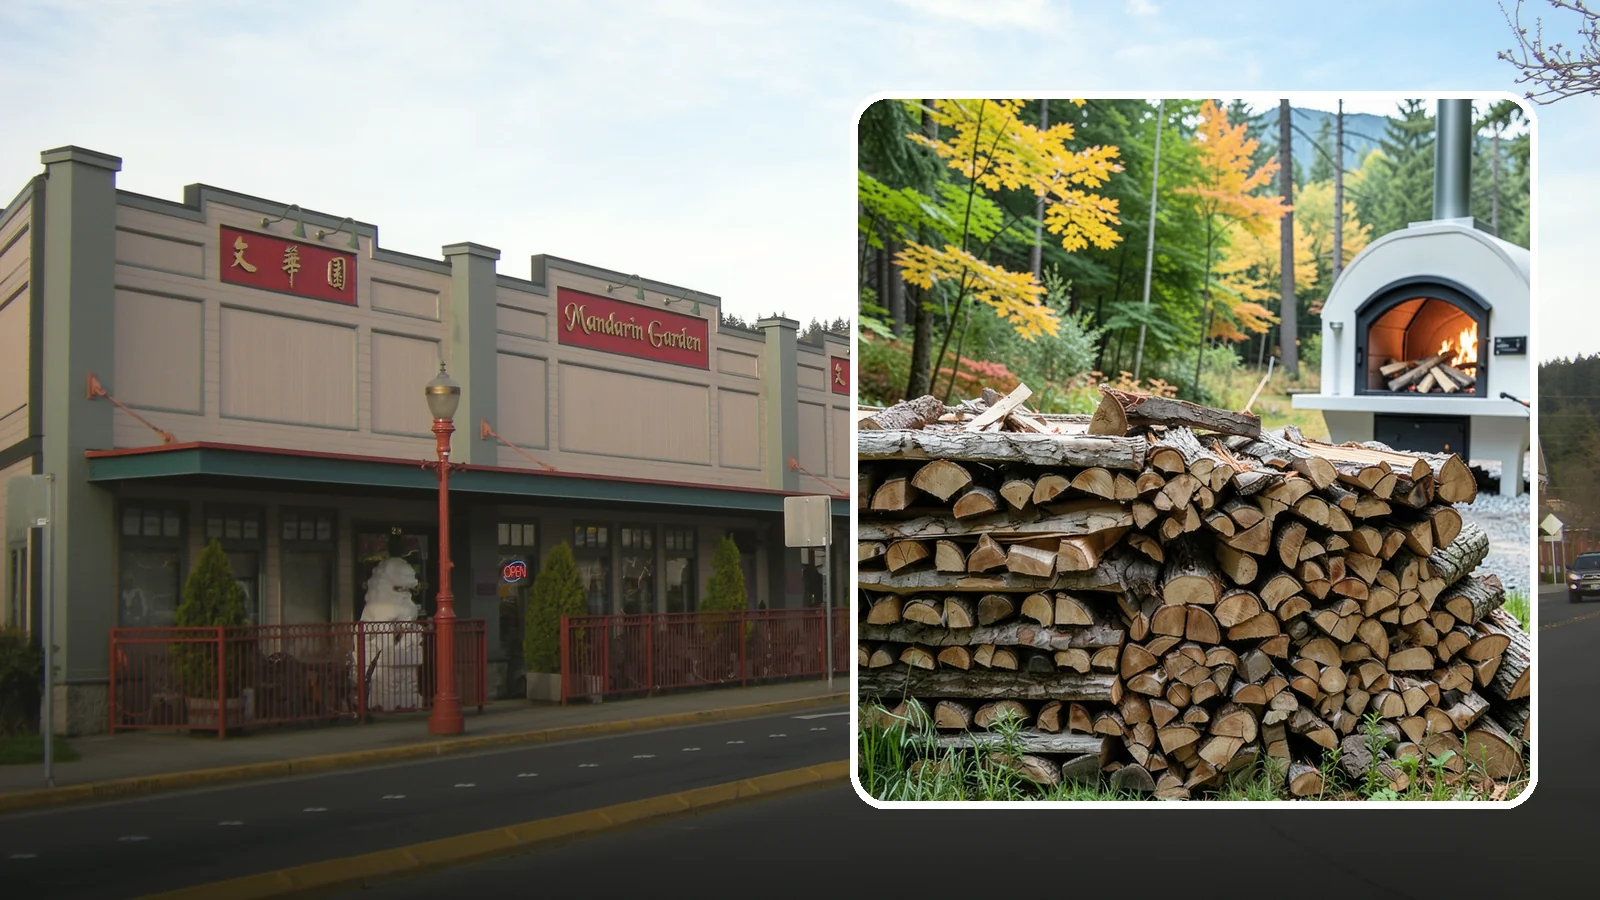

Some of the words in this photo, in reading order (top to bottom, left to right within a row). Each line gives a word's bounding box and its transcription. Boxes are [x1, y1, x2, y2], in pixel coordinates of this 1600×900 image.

[564, 302, 644, 341] Mandarin
[647, 320, 702, 352] Garden
[503, 565, 527, 578] OPEN
